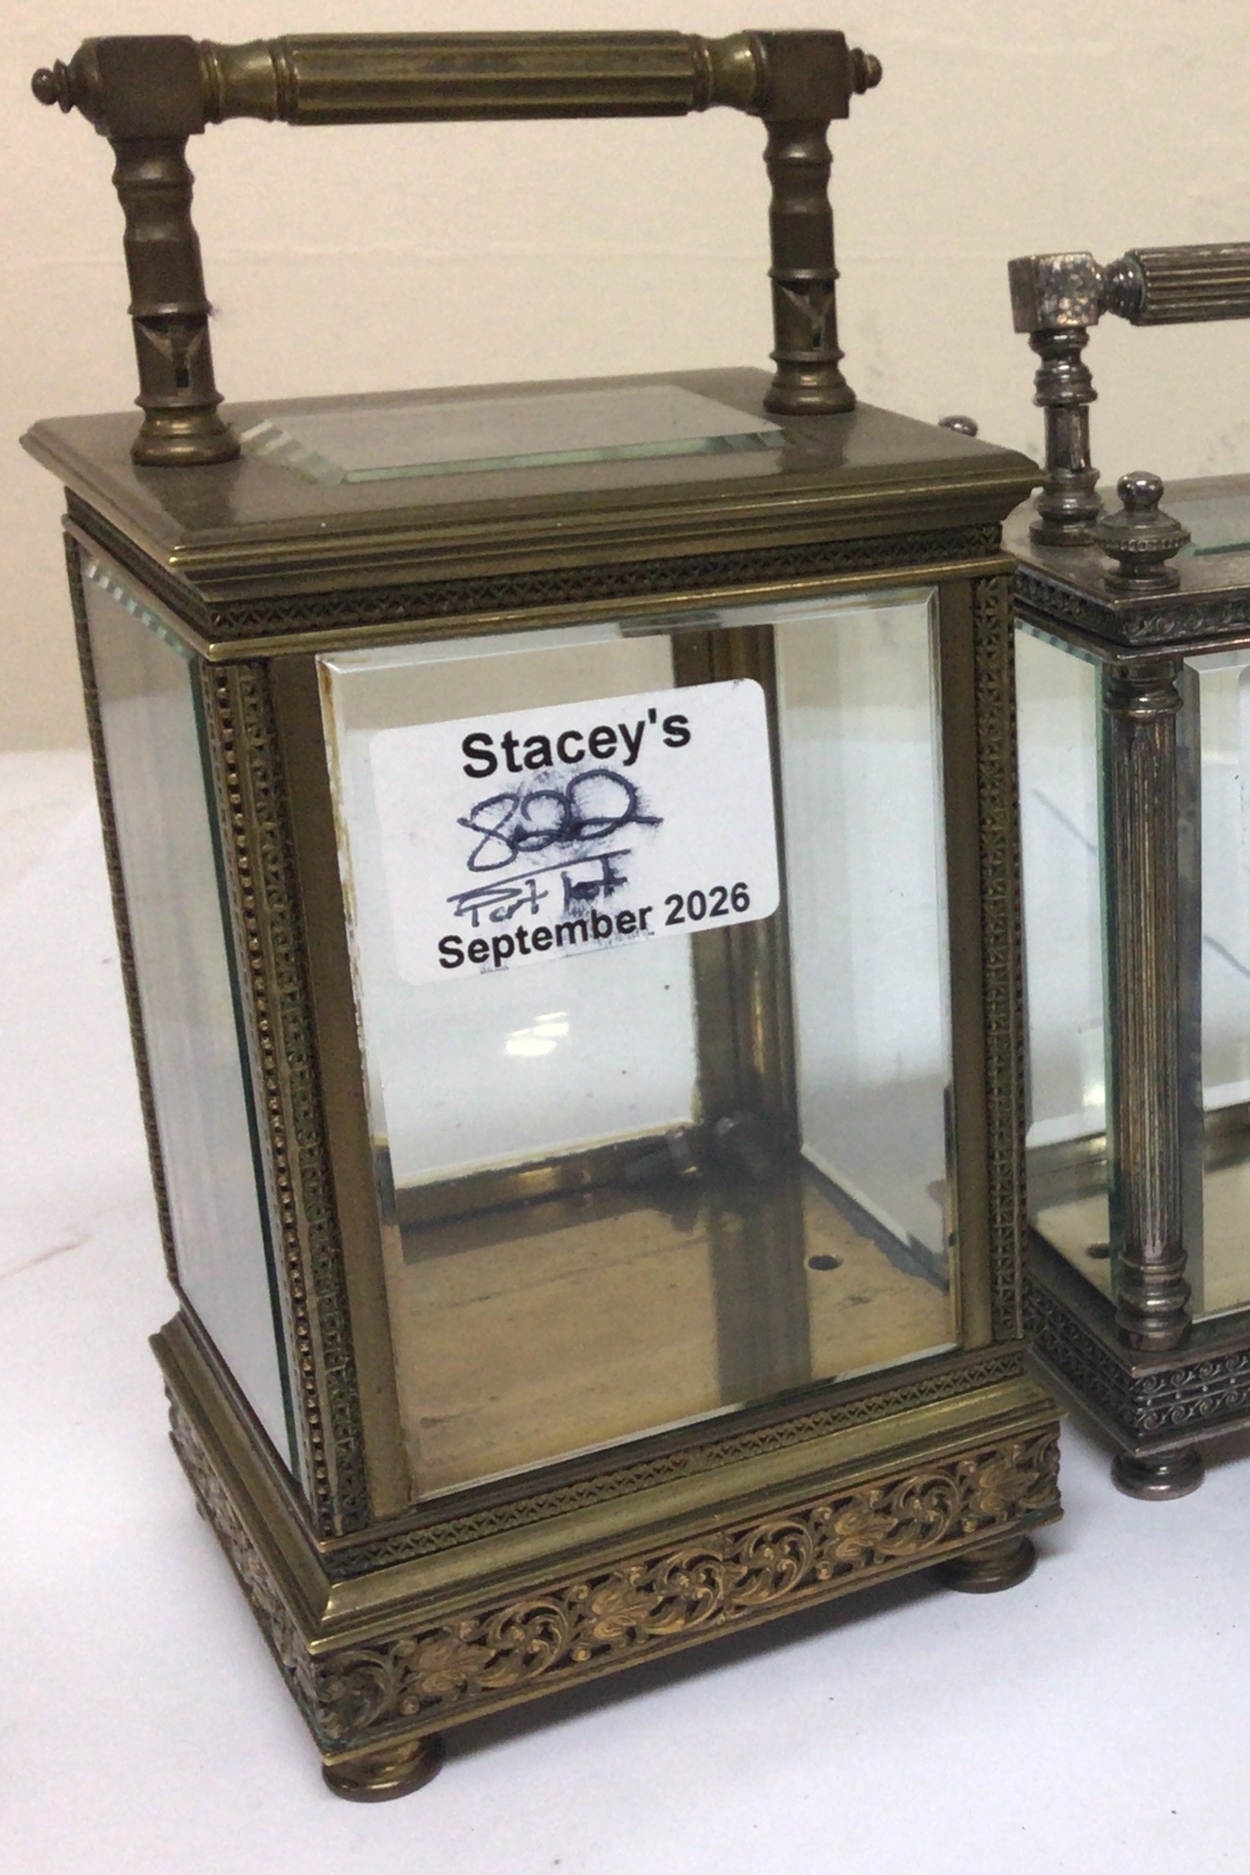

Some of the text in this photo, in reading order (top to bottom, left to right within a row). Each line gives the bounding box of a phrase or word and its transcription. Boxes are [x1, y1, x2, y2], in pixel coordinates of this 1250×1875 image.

[462, 708, 691, 779] Stacey's
[438, 882, 751, 969] September 2026
